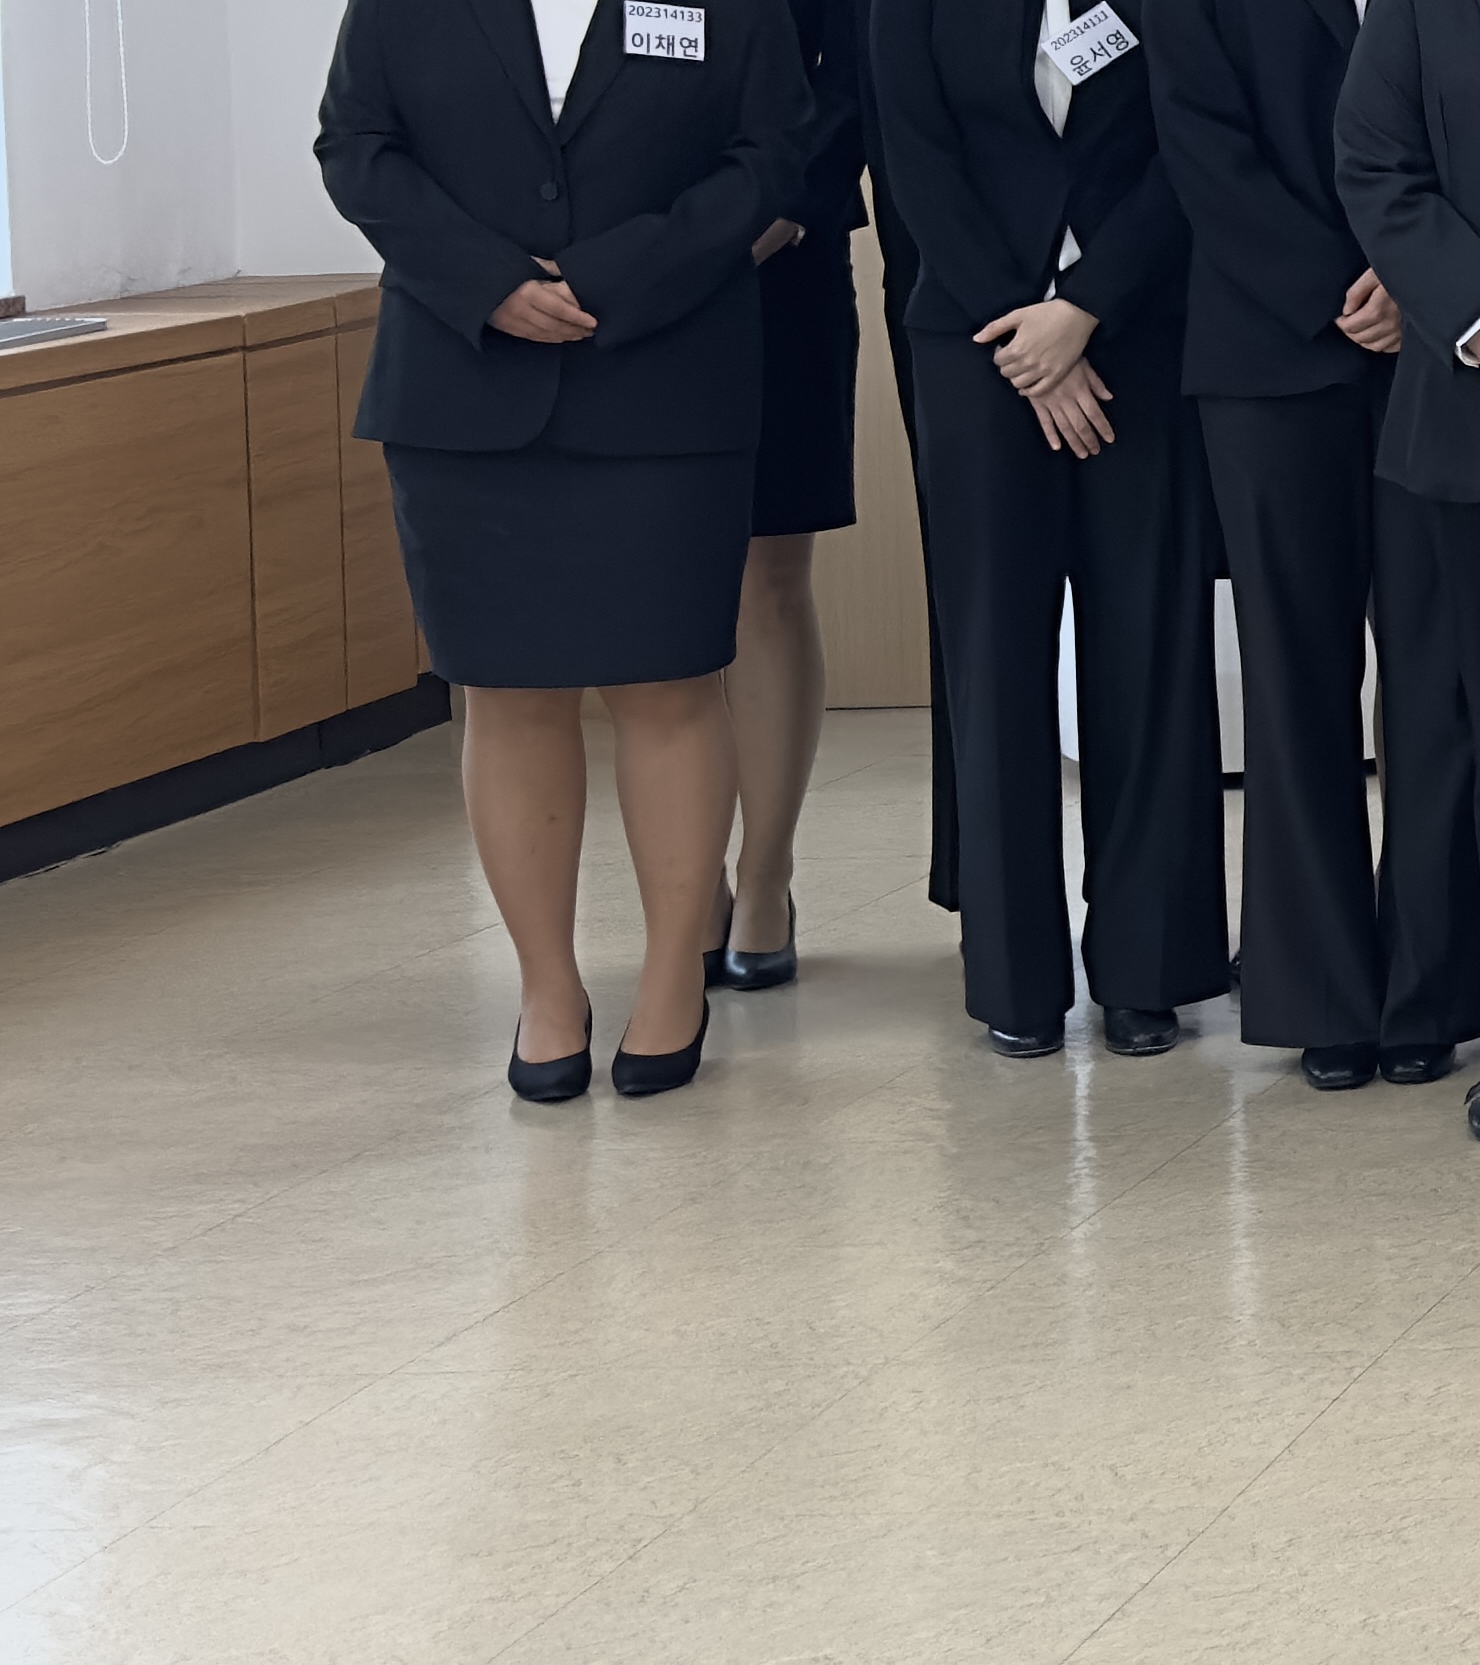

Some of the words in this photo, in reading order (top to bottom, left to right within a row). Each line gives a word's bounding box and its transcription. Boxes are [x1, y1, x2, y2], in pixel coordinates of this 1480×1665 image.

[628, 4, 703, 23] 202314133
[631, 32, 699, 59] 이채연
[1070, 29, 1129, 77] 윤서영
